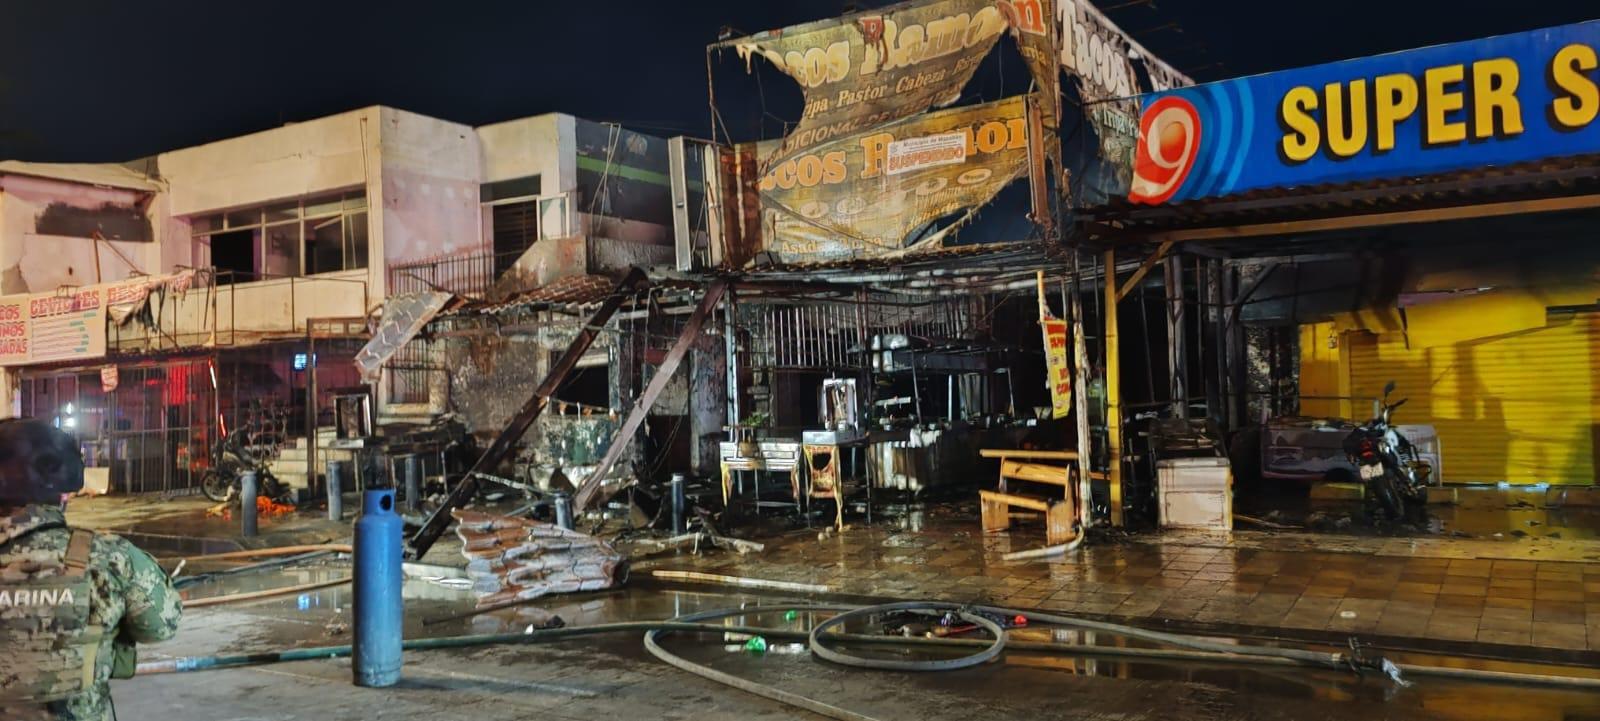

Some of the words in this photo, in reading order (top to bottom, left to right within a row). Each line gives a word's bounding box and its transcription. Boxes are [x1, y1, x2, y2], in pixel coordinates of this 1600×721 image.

[804, 97, 829, 121] ripa
[837, 84, 888, 107] Pastor
[895, 68, 946, 94] Cabeza
[1281, 57, 1524, 161] SUPER
[889, 145, 964, 171] SUSPENDIDO
[0, 587, 75, 608] ARINA
